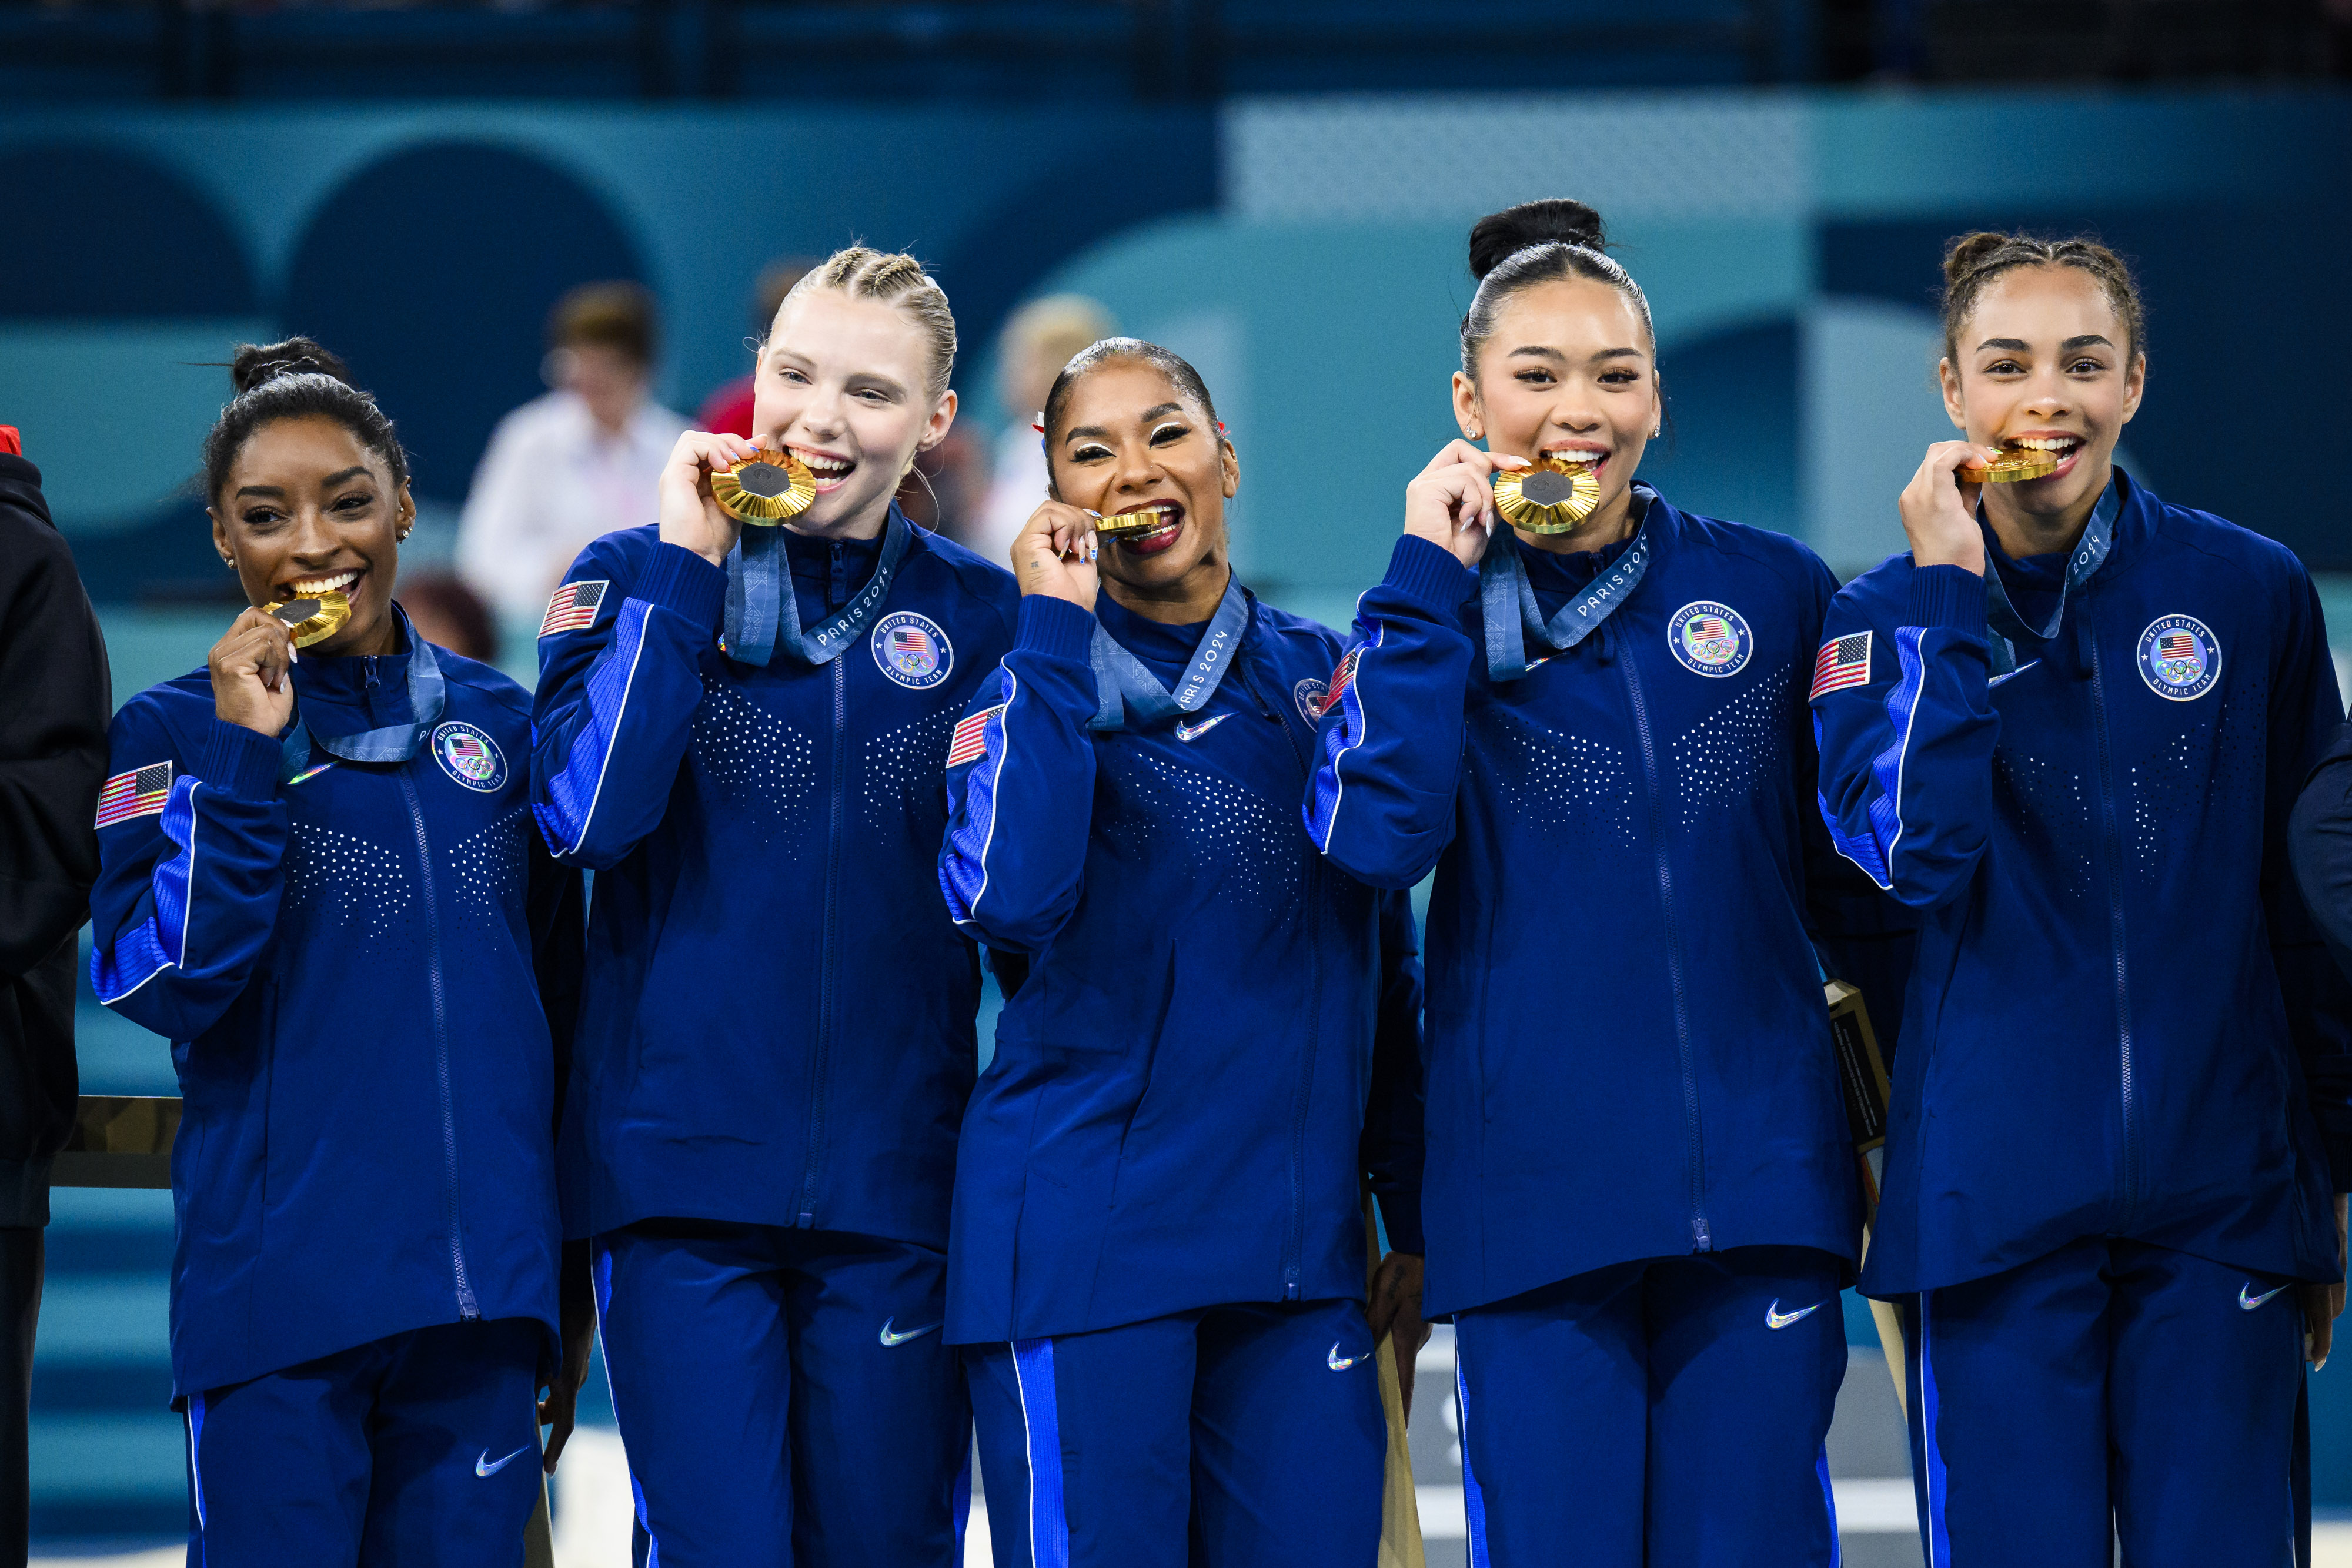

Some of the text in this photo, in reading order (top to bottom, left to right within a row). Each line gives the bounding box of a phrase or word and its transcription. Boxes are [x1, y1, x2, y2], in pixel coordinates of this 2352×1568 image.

[1623, 533, 1647, 574] 2024
[2073, 535, 2100, 576] 2024
[863, 567, 887, 608] 2024
[880, 616, 938, 638] UNITED STATES
[1675, 606, 1734, 628] UNITED STATES
[2145, 619, 2205, 643] UNITED STATES
[1200, 630, 1228, 673] 2024
[1687, 653, 1745, 673] OLYMPIC TEAM
[886, 666, 944, 685] OLYMPIC TEAM
[2152, 673, 2211, 696] OLYMPIC TEAM
[437, 726, 458, 741] UNITED
[460, 726, 489, 744] STATES
[452, 770, 486, 788] OLYMPIC
